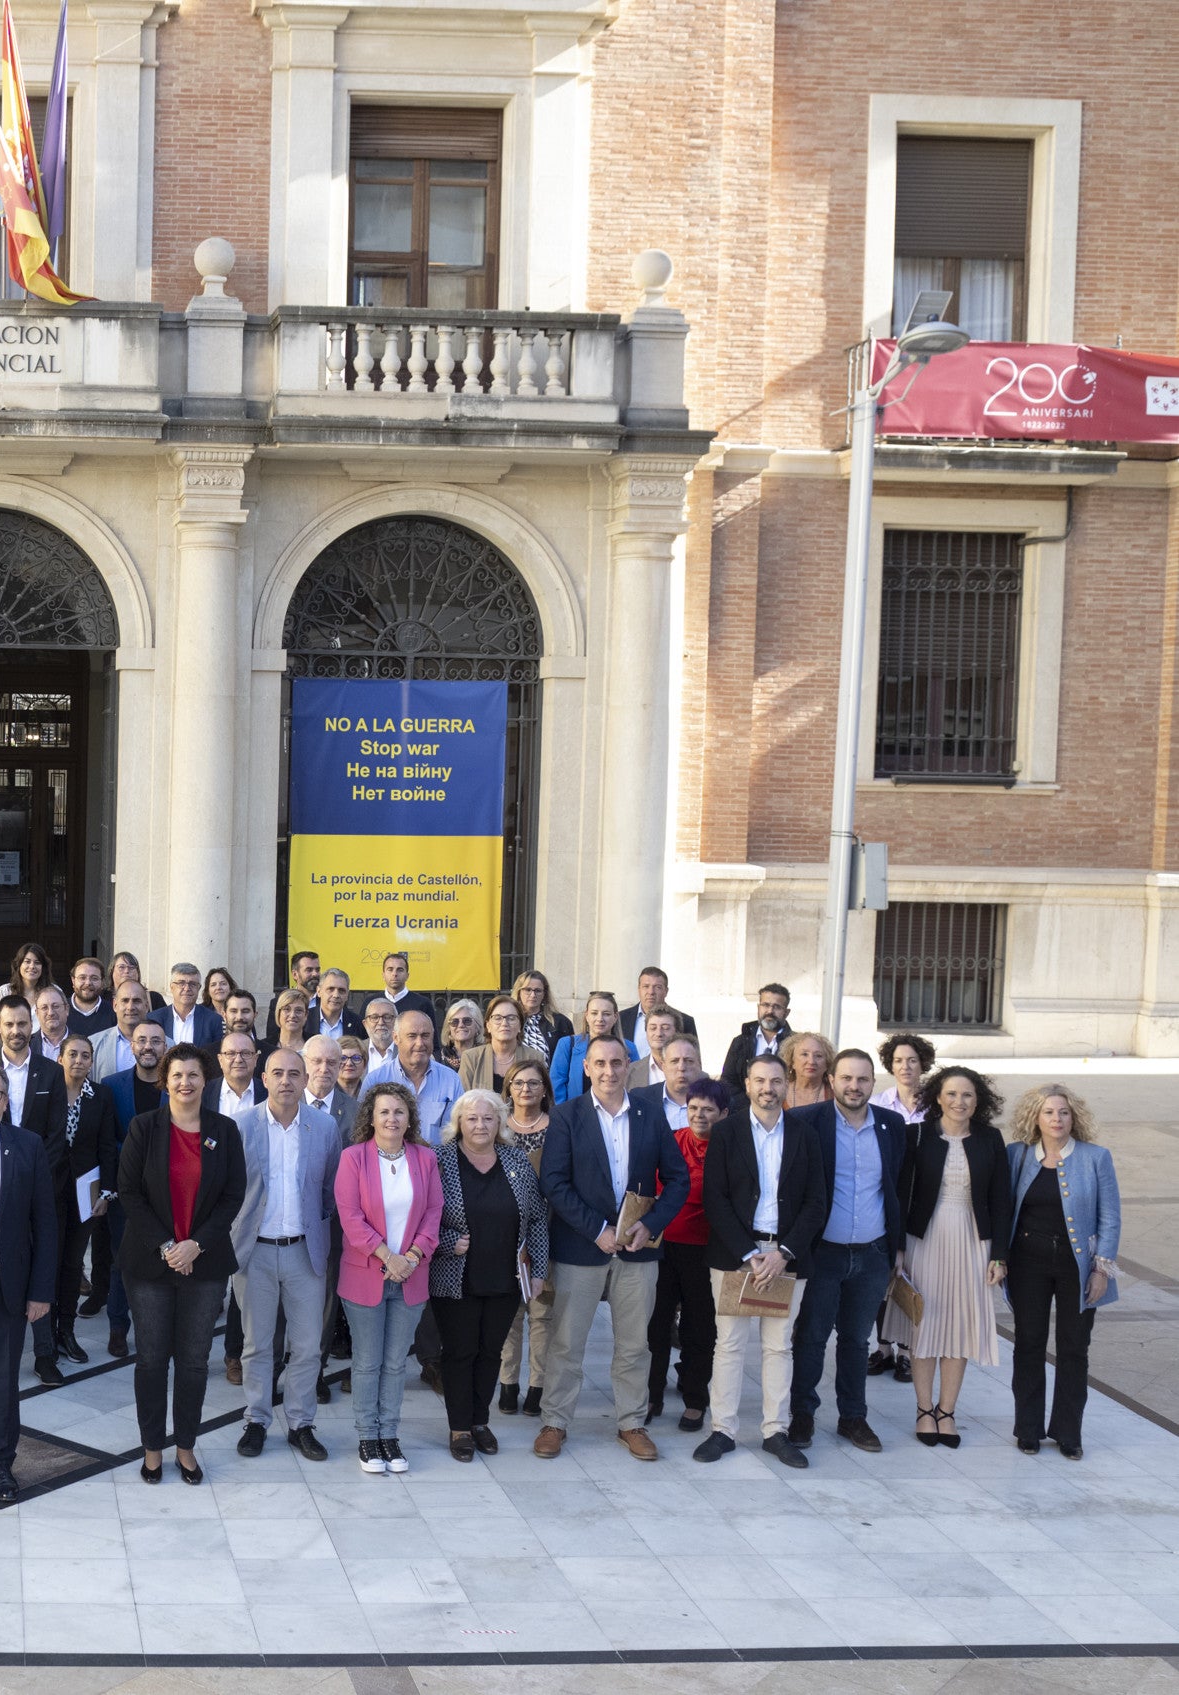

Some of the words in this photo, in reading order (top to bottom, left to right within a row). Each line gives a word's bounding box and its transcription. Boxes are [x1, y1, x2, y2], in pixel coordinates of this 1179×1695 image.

[983, 357, 1097, 416] 200
[1023, 408, 1094, 418] ANIVERSARI
[325, 717, 351, 732] NO
[355, 717, 368, 732] A
[373, 718, 396, 733] LA
[400, 718, 475, 733] GUERRA
[360, 740, 402, 759] Stop
[408, 743, 440, 756] war
[347, 762, 370, 778] Не
[376, 765, 397, 778] на
[403, 763, 452, 782] війну
[352, 785, 385, 801] Нет
[390, 786, 446, 801] войне
[311, 872, 327, 885] La
[331, 873, 393, 886] provincia
[397, 874, 414, 886] de
[417, 874, 482, 887] Castellón,
[334, 891, 357, 903] por
[360, 889, 372, 901] la
[375, 892, 399, 904] paz
[403, 890, 459, 902] mundial.
[333, 914, 390, 928] Fuerza
[396, 915, 458, 929] Ucrania
